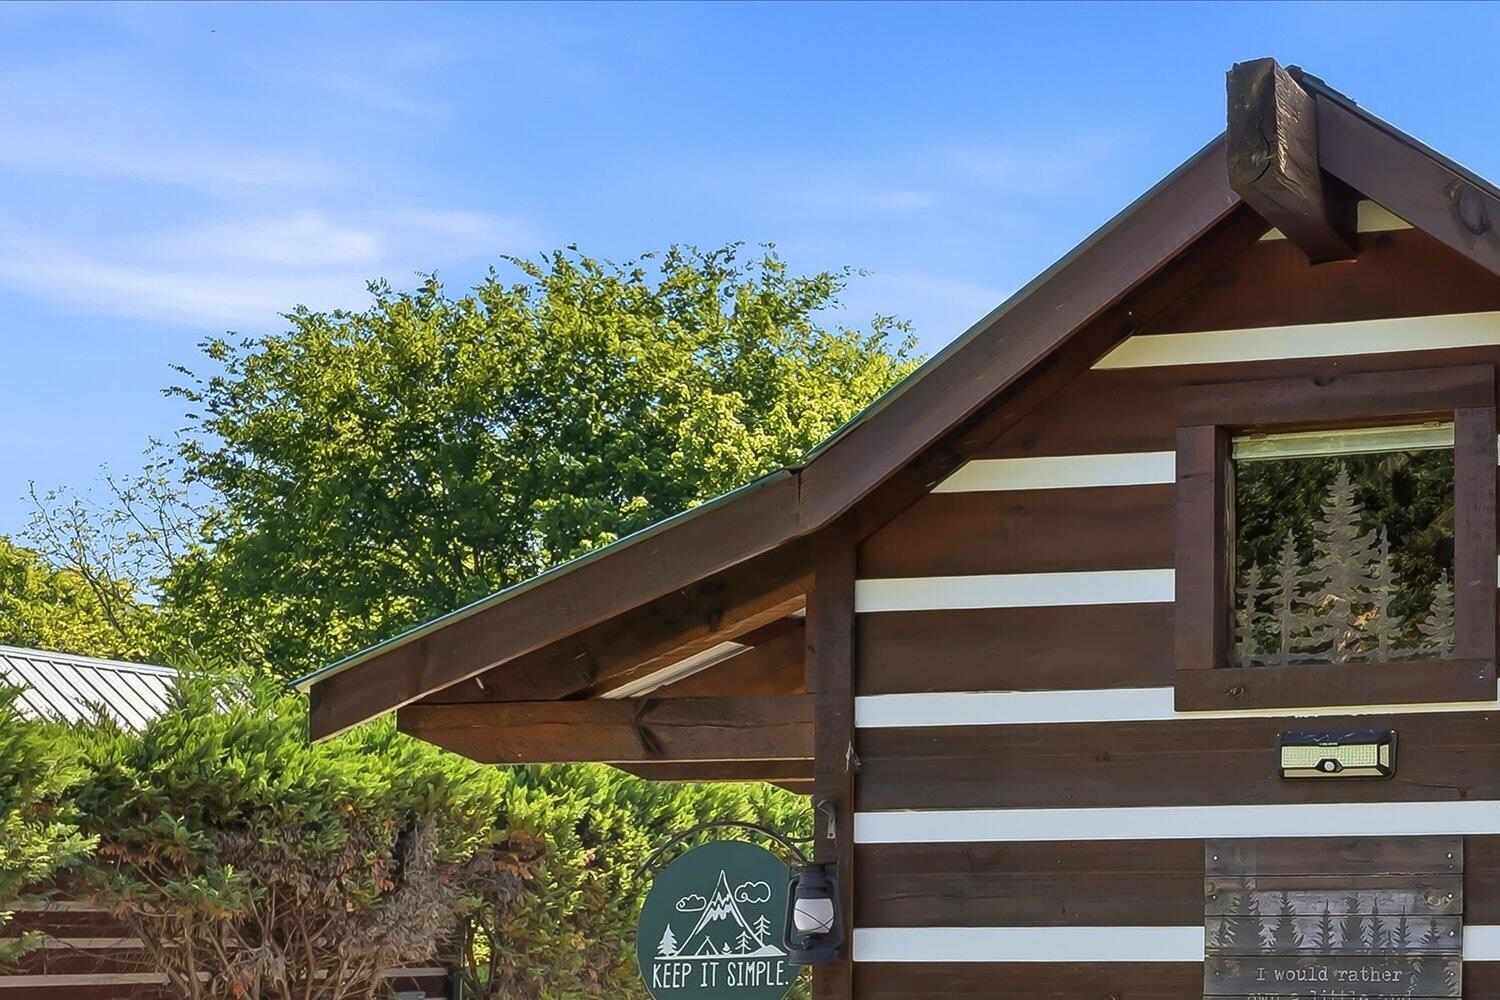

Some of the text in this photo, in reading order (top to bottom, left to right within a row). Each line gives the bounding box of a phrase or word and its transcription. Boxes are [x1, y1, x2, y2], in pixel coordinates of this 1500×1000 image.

[652, 960, 790, 989] KEEP IT SIMPLE.
[1256, 966, 1403, 982] I would rather
